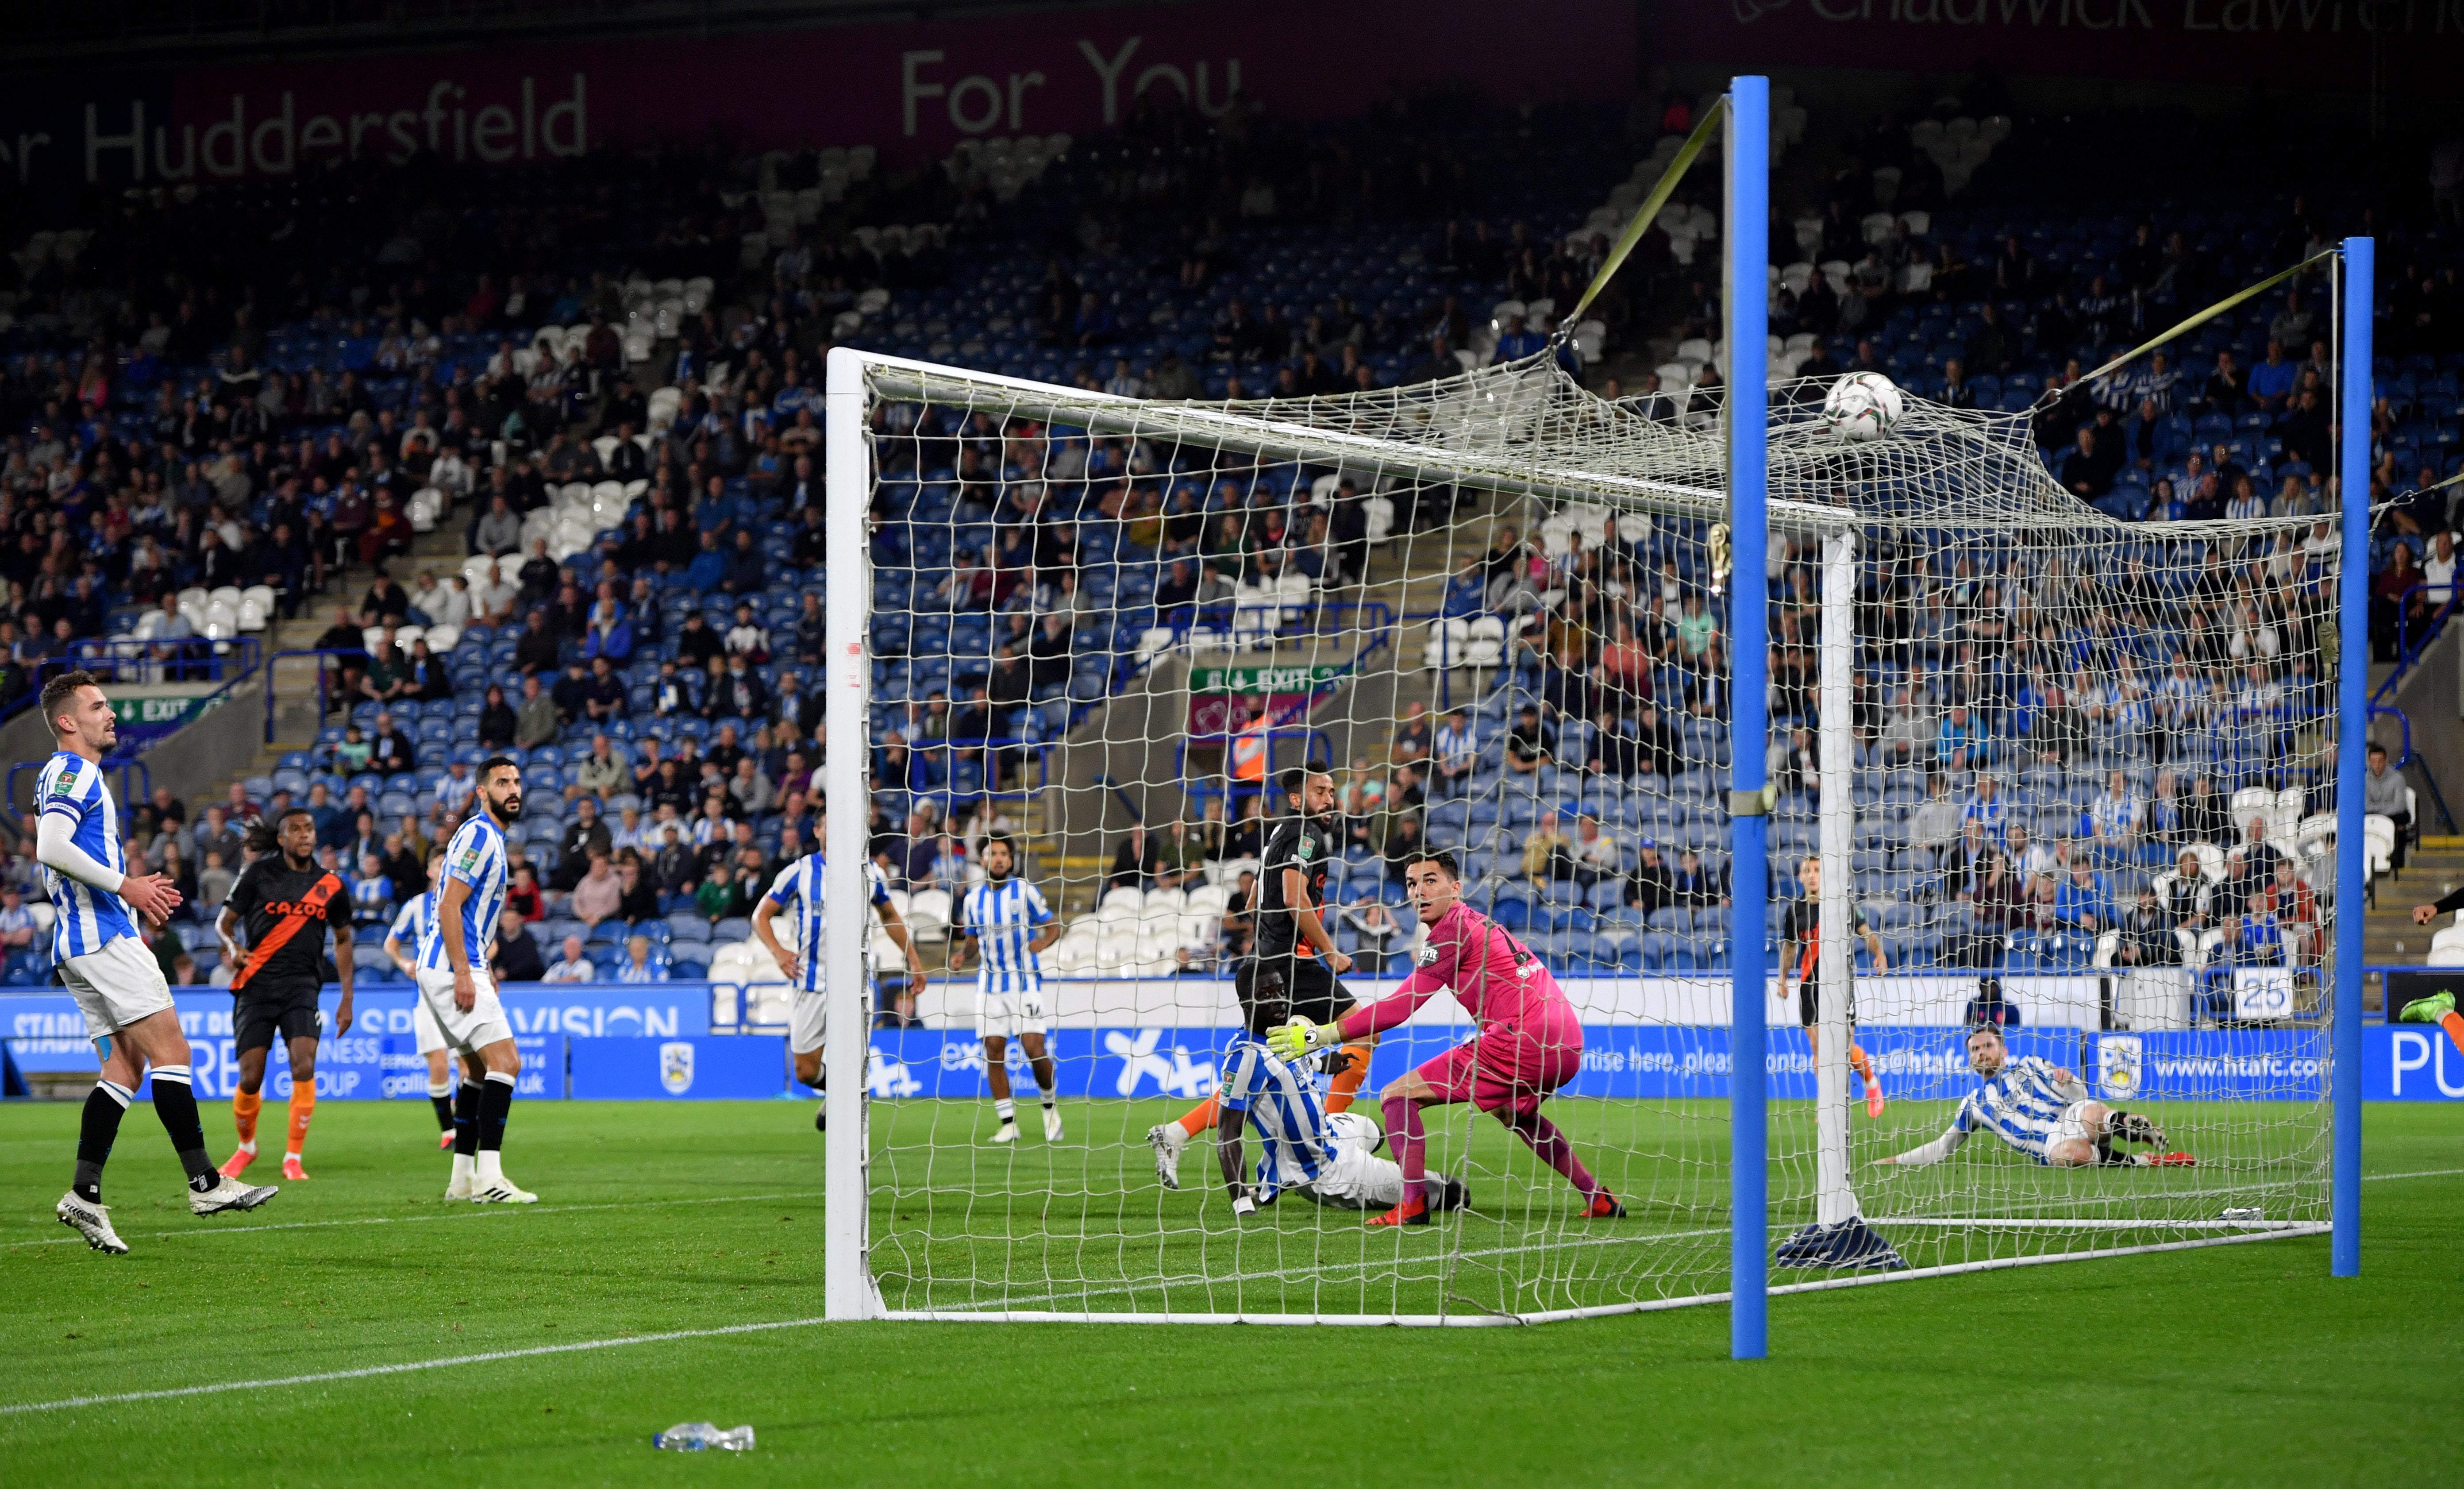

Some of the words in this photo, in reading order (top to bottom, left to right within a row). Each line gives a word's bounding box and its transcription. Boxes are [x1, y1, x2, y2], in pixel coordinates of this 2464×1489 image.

[901, 48, 1047, 140] For
[84, 72, 589, 183] Huddersfield
[1256, 667, 1308, 692] EXIT
[264, 901, 327, 920] CAZOO
[1629, 1045, 1679, 1076] here,
[1684, 1045, 1733, 1080] pleas
[2392, 1031, 2464, 1098] PU
[273, 1070, 361, 1097] GOUP
